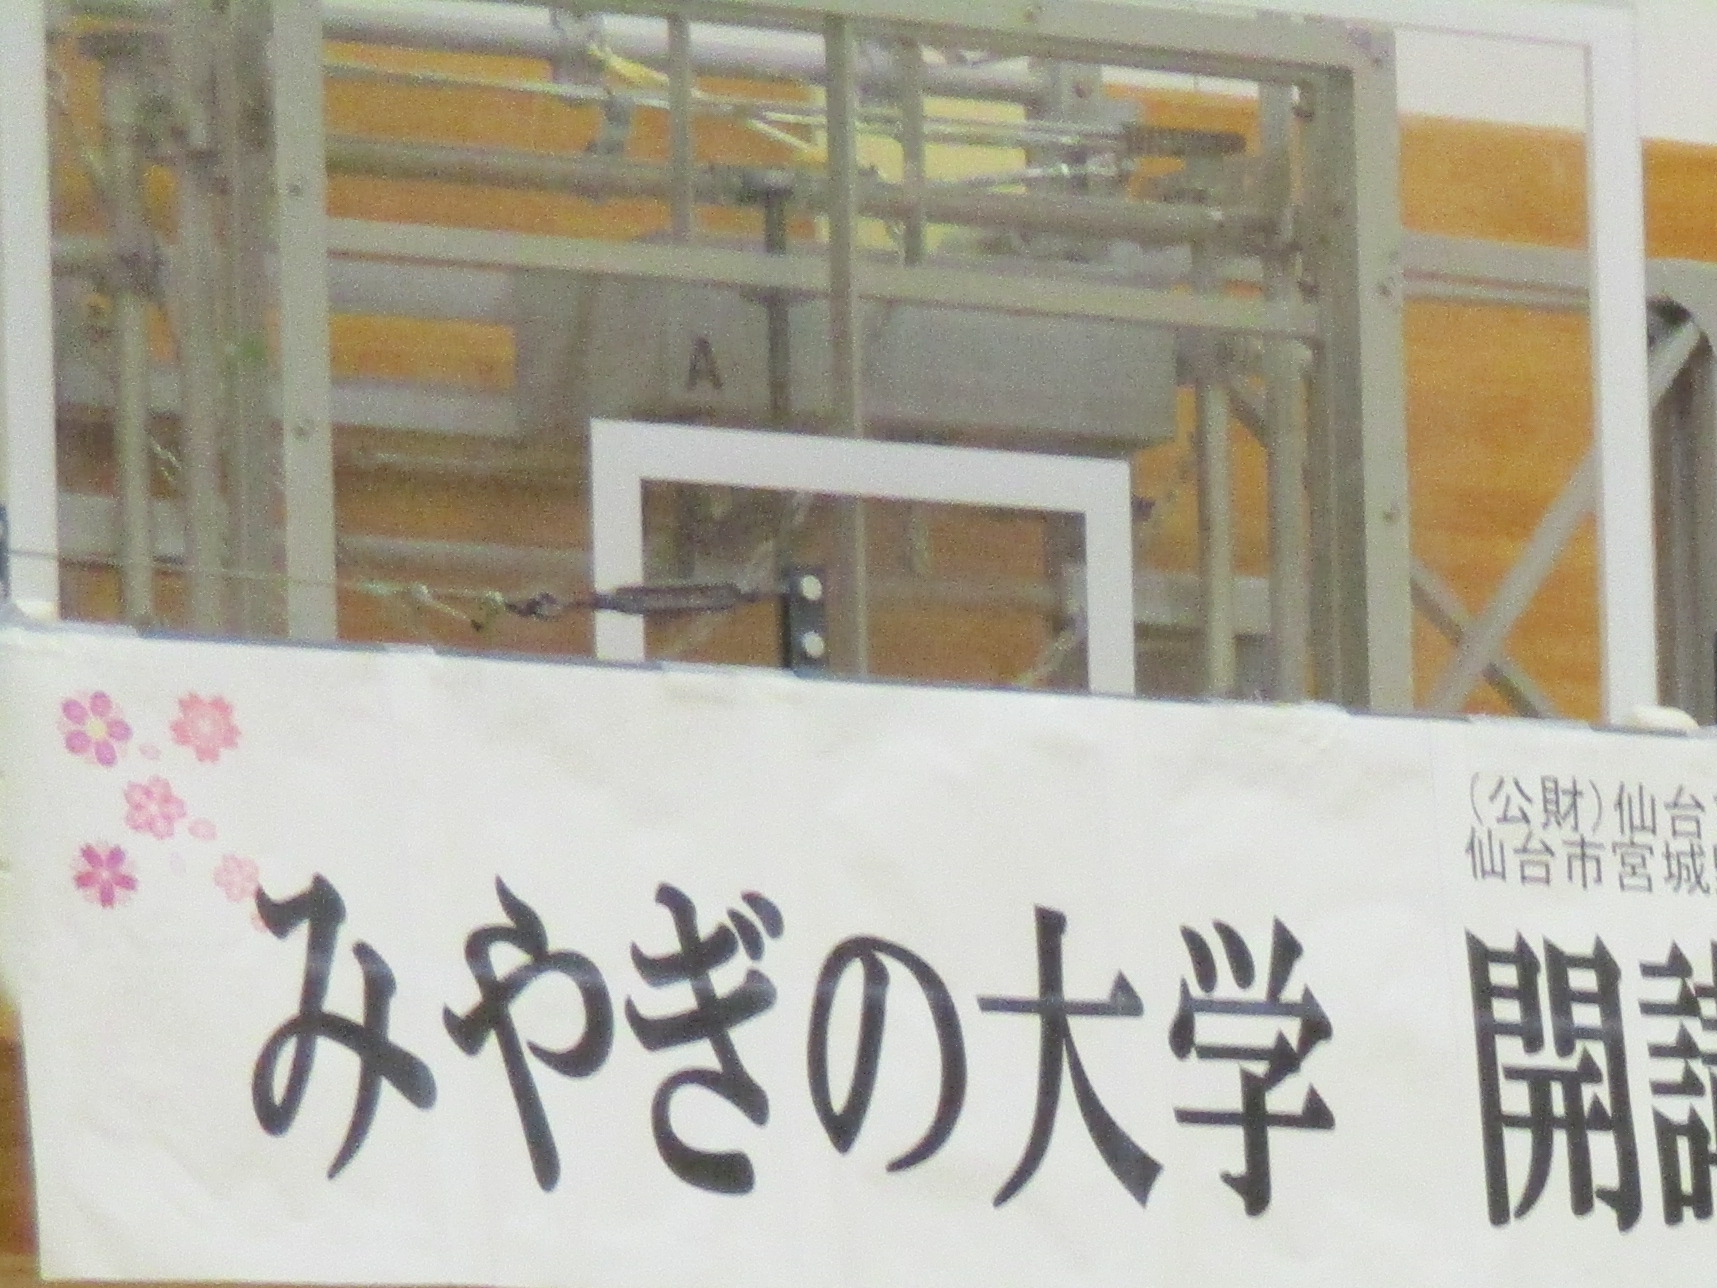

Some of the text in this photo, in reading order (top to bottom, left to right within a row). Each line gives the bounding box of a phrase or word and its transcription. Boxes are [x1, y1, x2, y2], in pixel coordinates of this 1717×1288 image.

[686, 335, 723, 391] A
[252, 875, 1335, 1217] みやぎの大学
